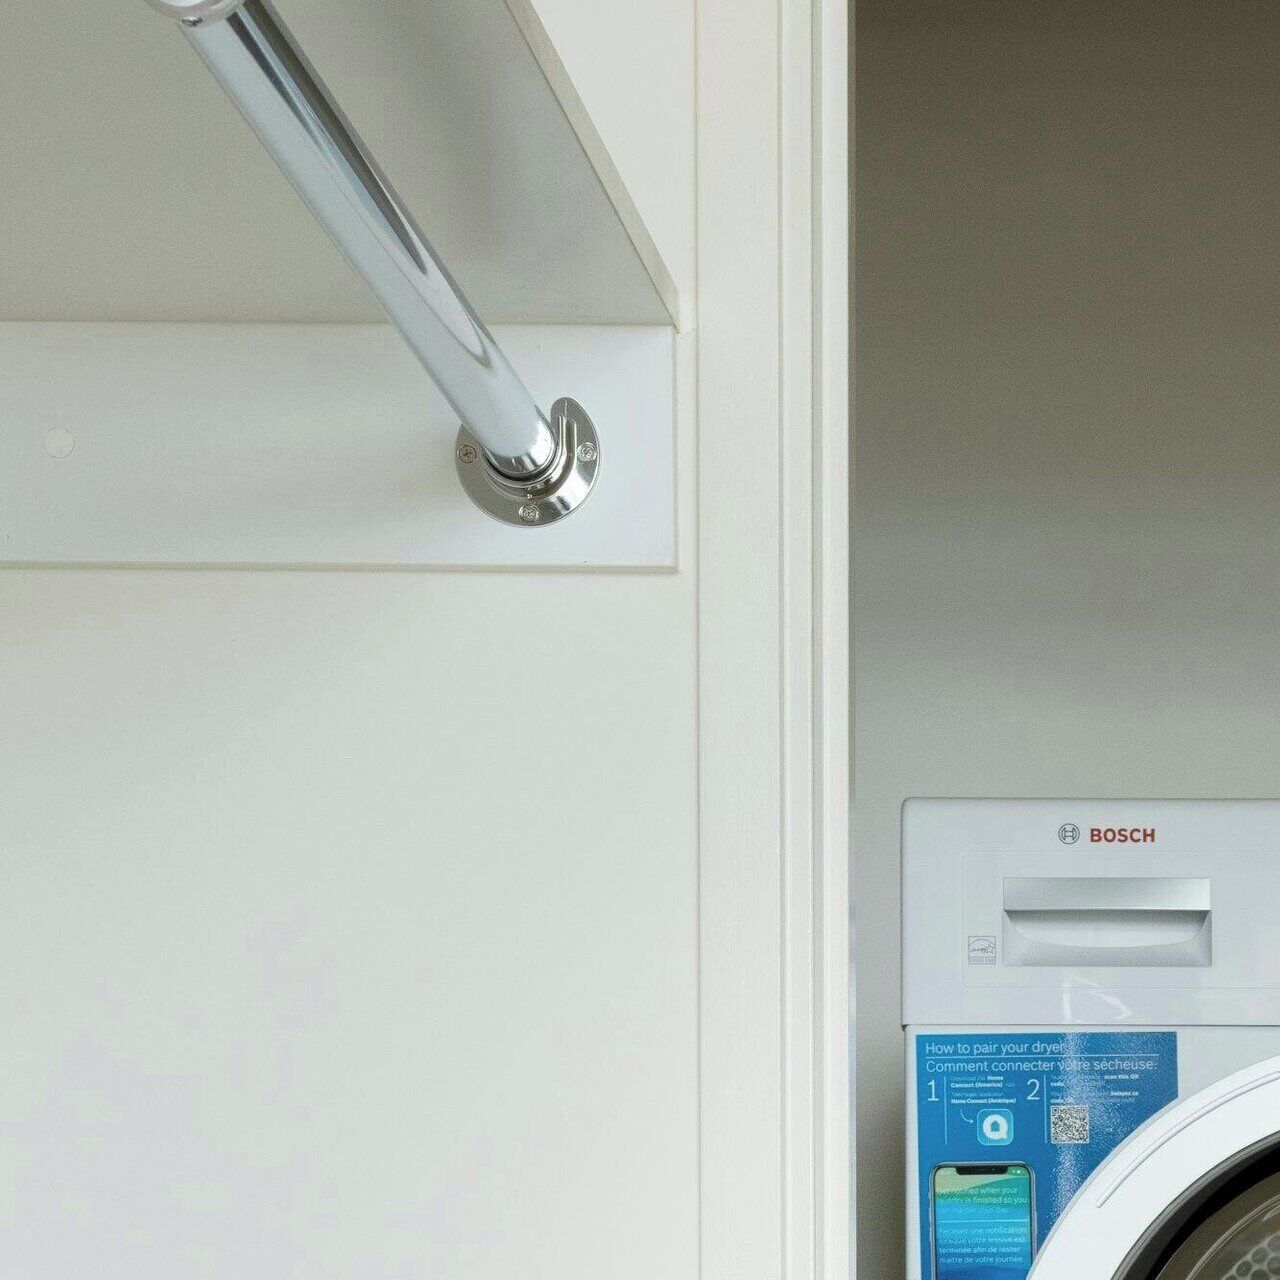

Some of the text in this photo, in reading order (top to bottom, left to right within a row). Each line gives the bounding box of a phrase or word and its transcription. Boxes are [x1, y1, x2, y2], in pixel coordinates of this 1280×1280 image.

[1090, 828, 1155, 842] BOSCH
[925, 1042, 954, 1054] How
[957, 1042, 970, 1054] to
[973, 1041, 998, 1056] pair
[1001, 1043, 1028, 1056] your
[926, 1058, 1157, 1072] Comment connecter votre sécheuse:
[927, 1079, 939, 1101] 1
[1027, 1079, 1040, 1100] 2
